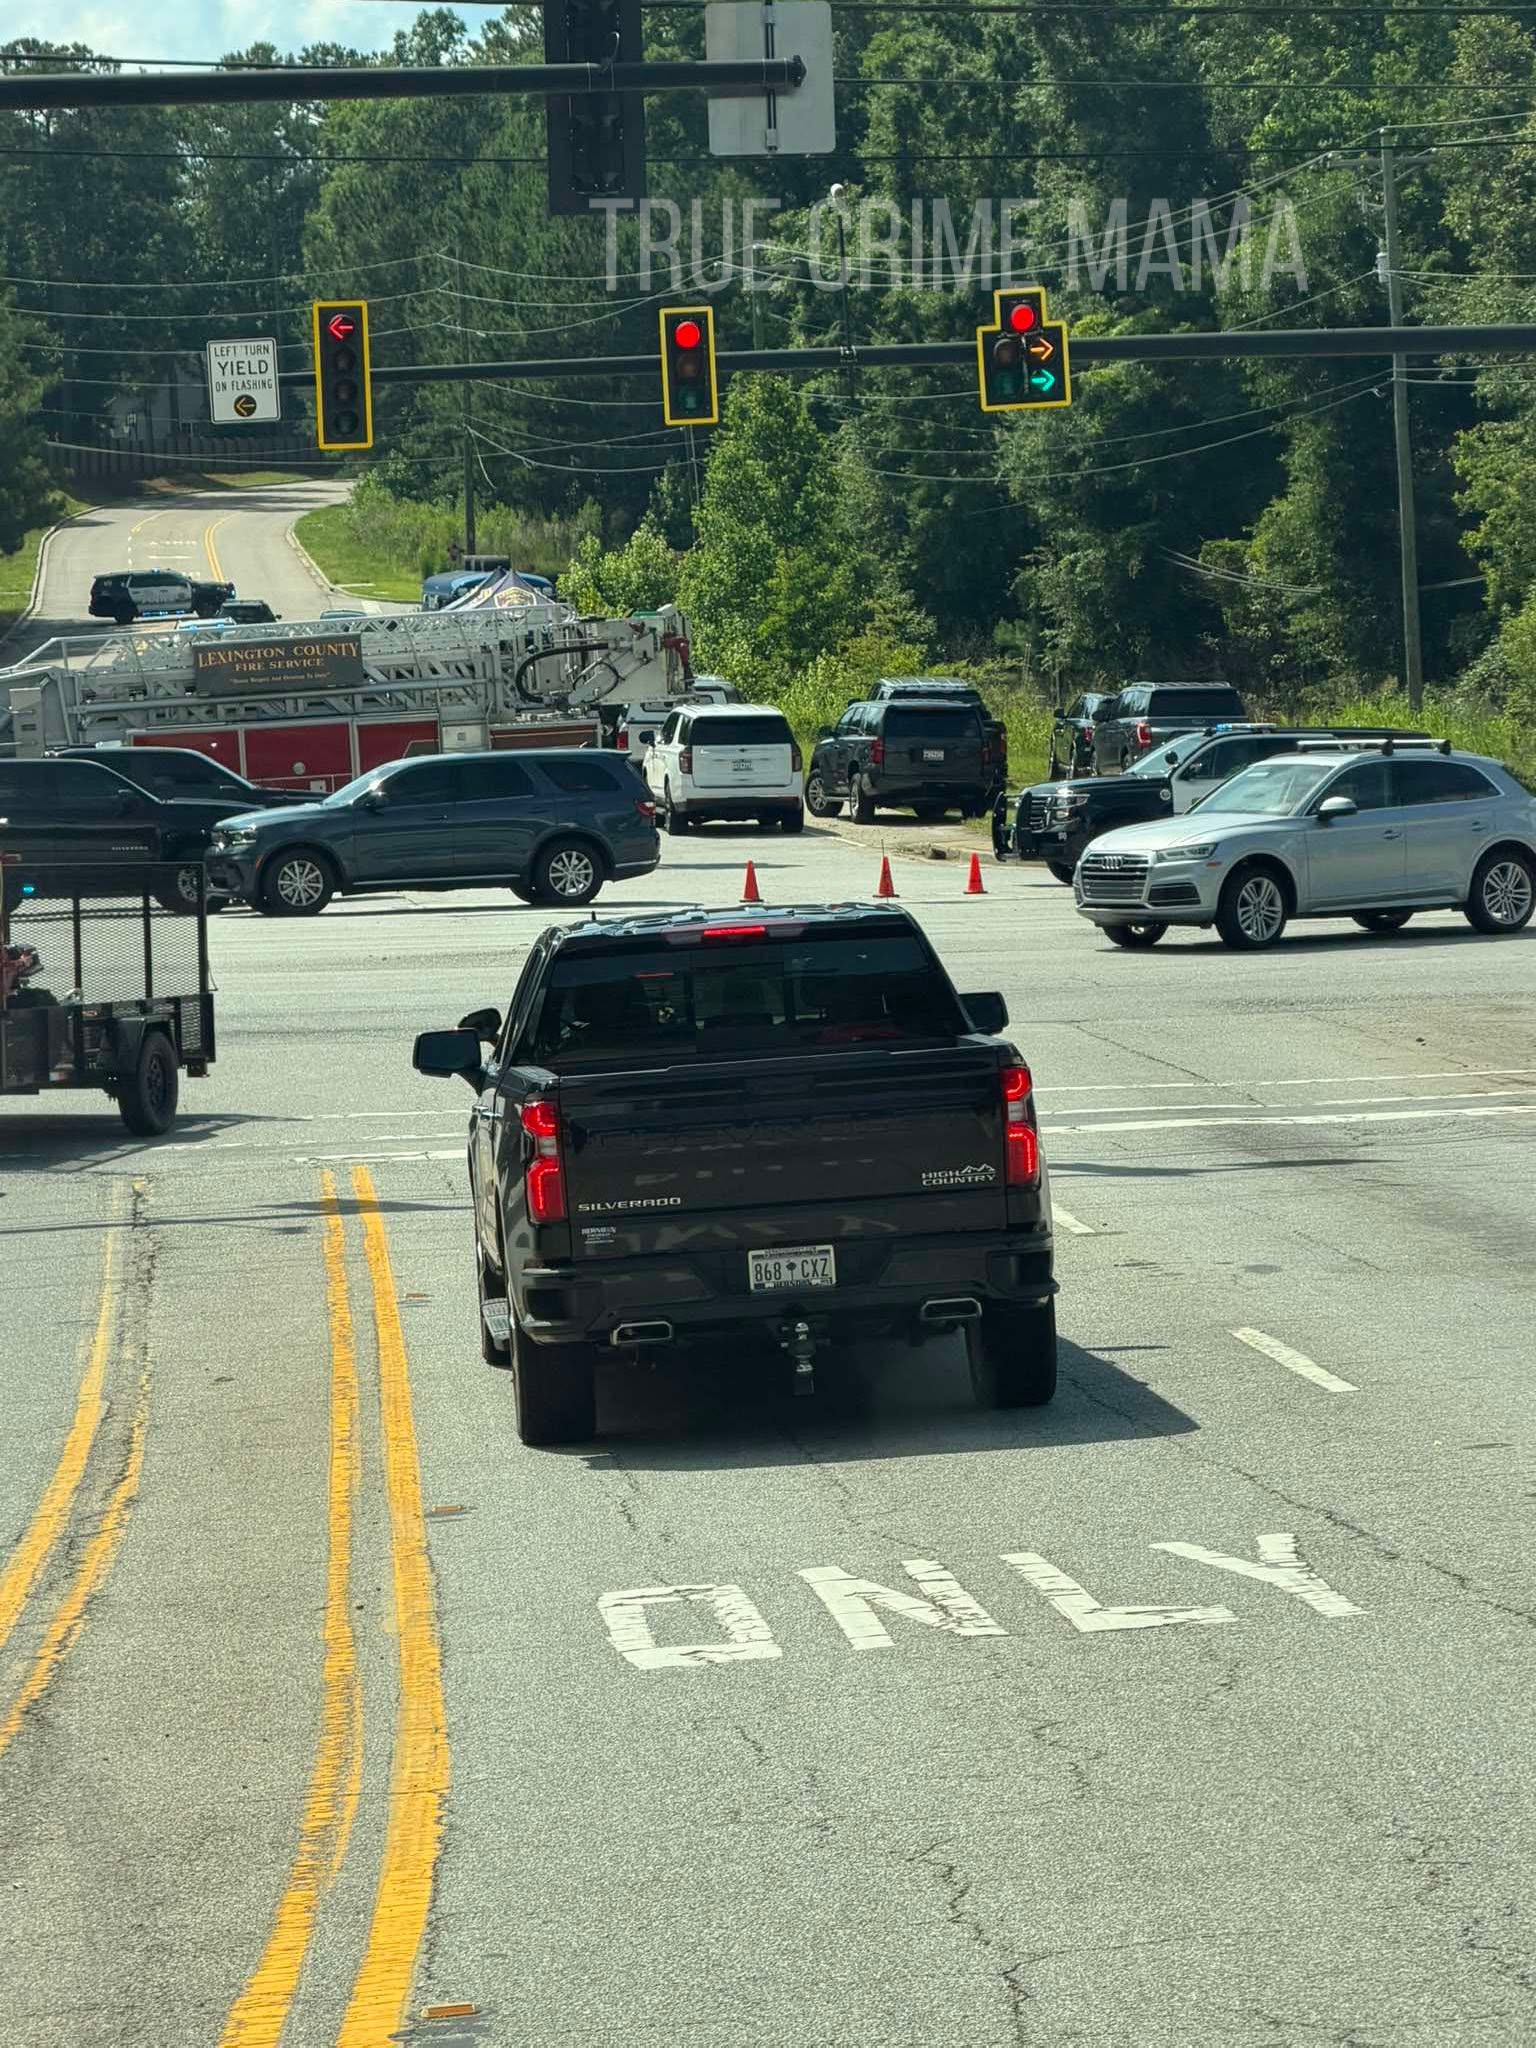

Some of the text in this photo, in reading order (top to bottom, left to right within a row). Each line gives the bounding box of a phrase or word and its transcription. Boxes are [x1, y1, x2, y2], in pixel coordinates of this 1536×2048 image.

[214, 343, 270, 357] LEFT TURN
[217, 360, 269, 376] YIELD
[215, 378, 273, 392] ON FLASHING
[198, 642, 359, 668] LEXINGTON COUNTY
[234, 657, 325, 672] FIRE SERVICE
[921, 1170, 960, 1179] HIGH
[922, 1174, 996, 1186] COUNTRY
[578, 1197, 681, 1212] SILVERADO
[754, 1257, 829, 1282] 868 CXZ
[597, 1532, 1369, 1671] ONLY
